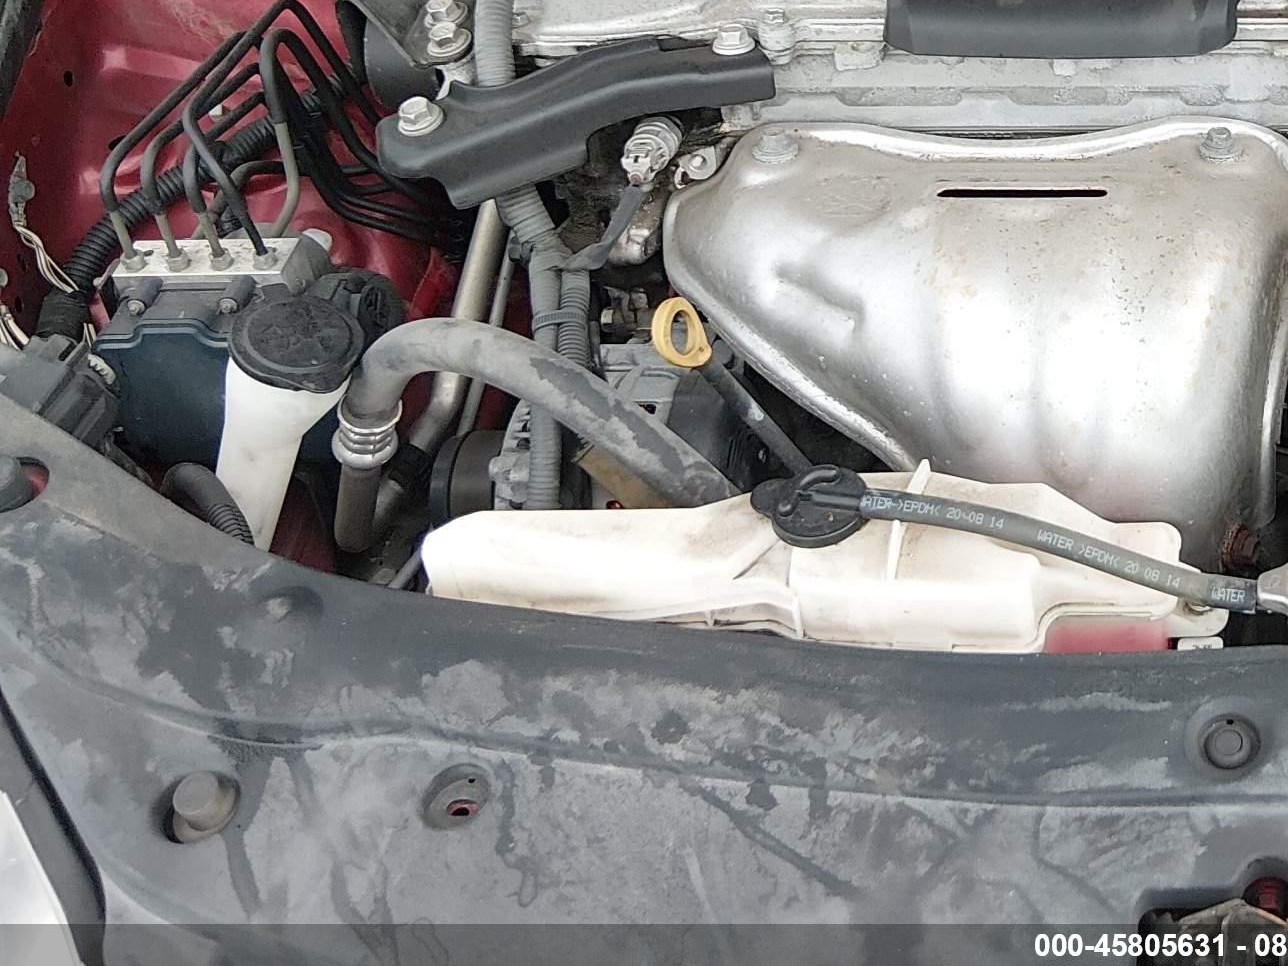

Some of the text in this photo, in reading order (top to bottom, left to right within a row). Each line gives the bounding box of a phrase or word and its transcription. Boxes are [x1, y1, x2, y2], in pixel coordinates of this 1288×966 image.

[1036, 529, 1075, 552] WATER
[1124, 560, 1139, 575] 20
[1144, 568, 1161, 583] 08
[1166, 574, 1182, 589] 14
[1210, 585, 1246, 603] WATER
